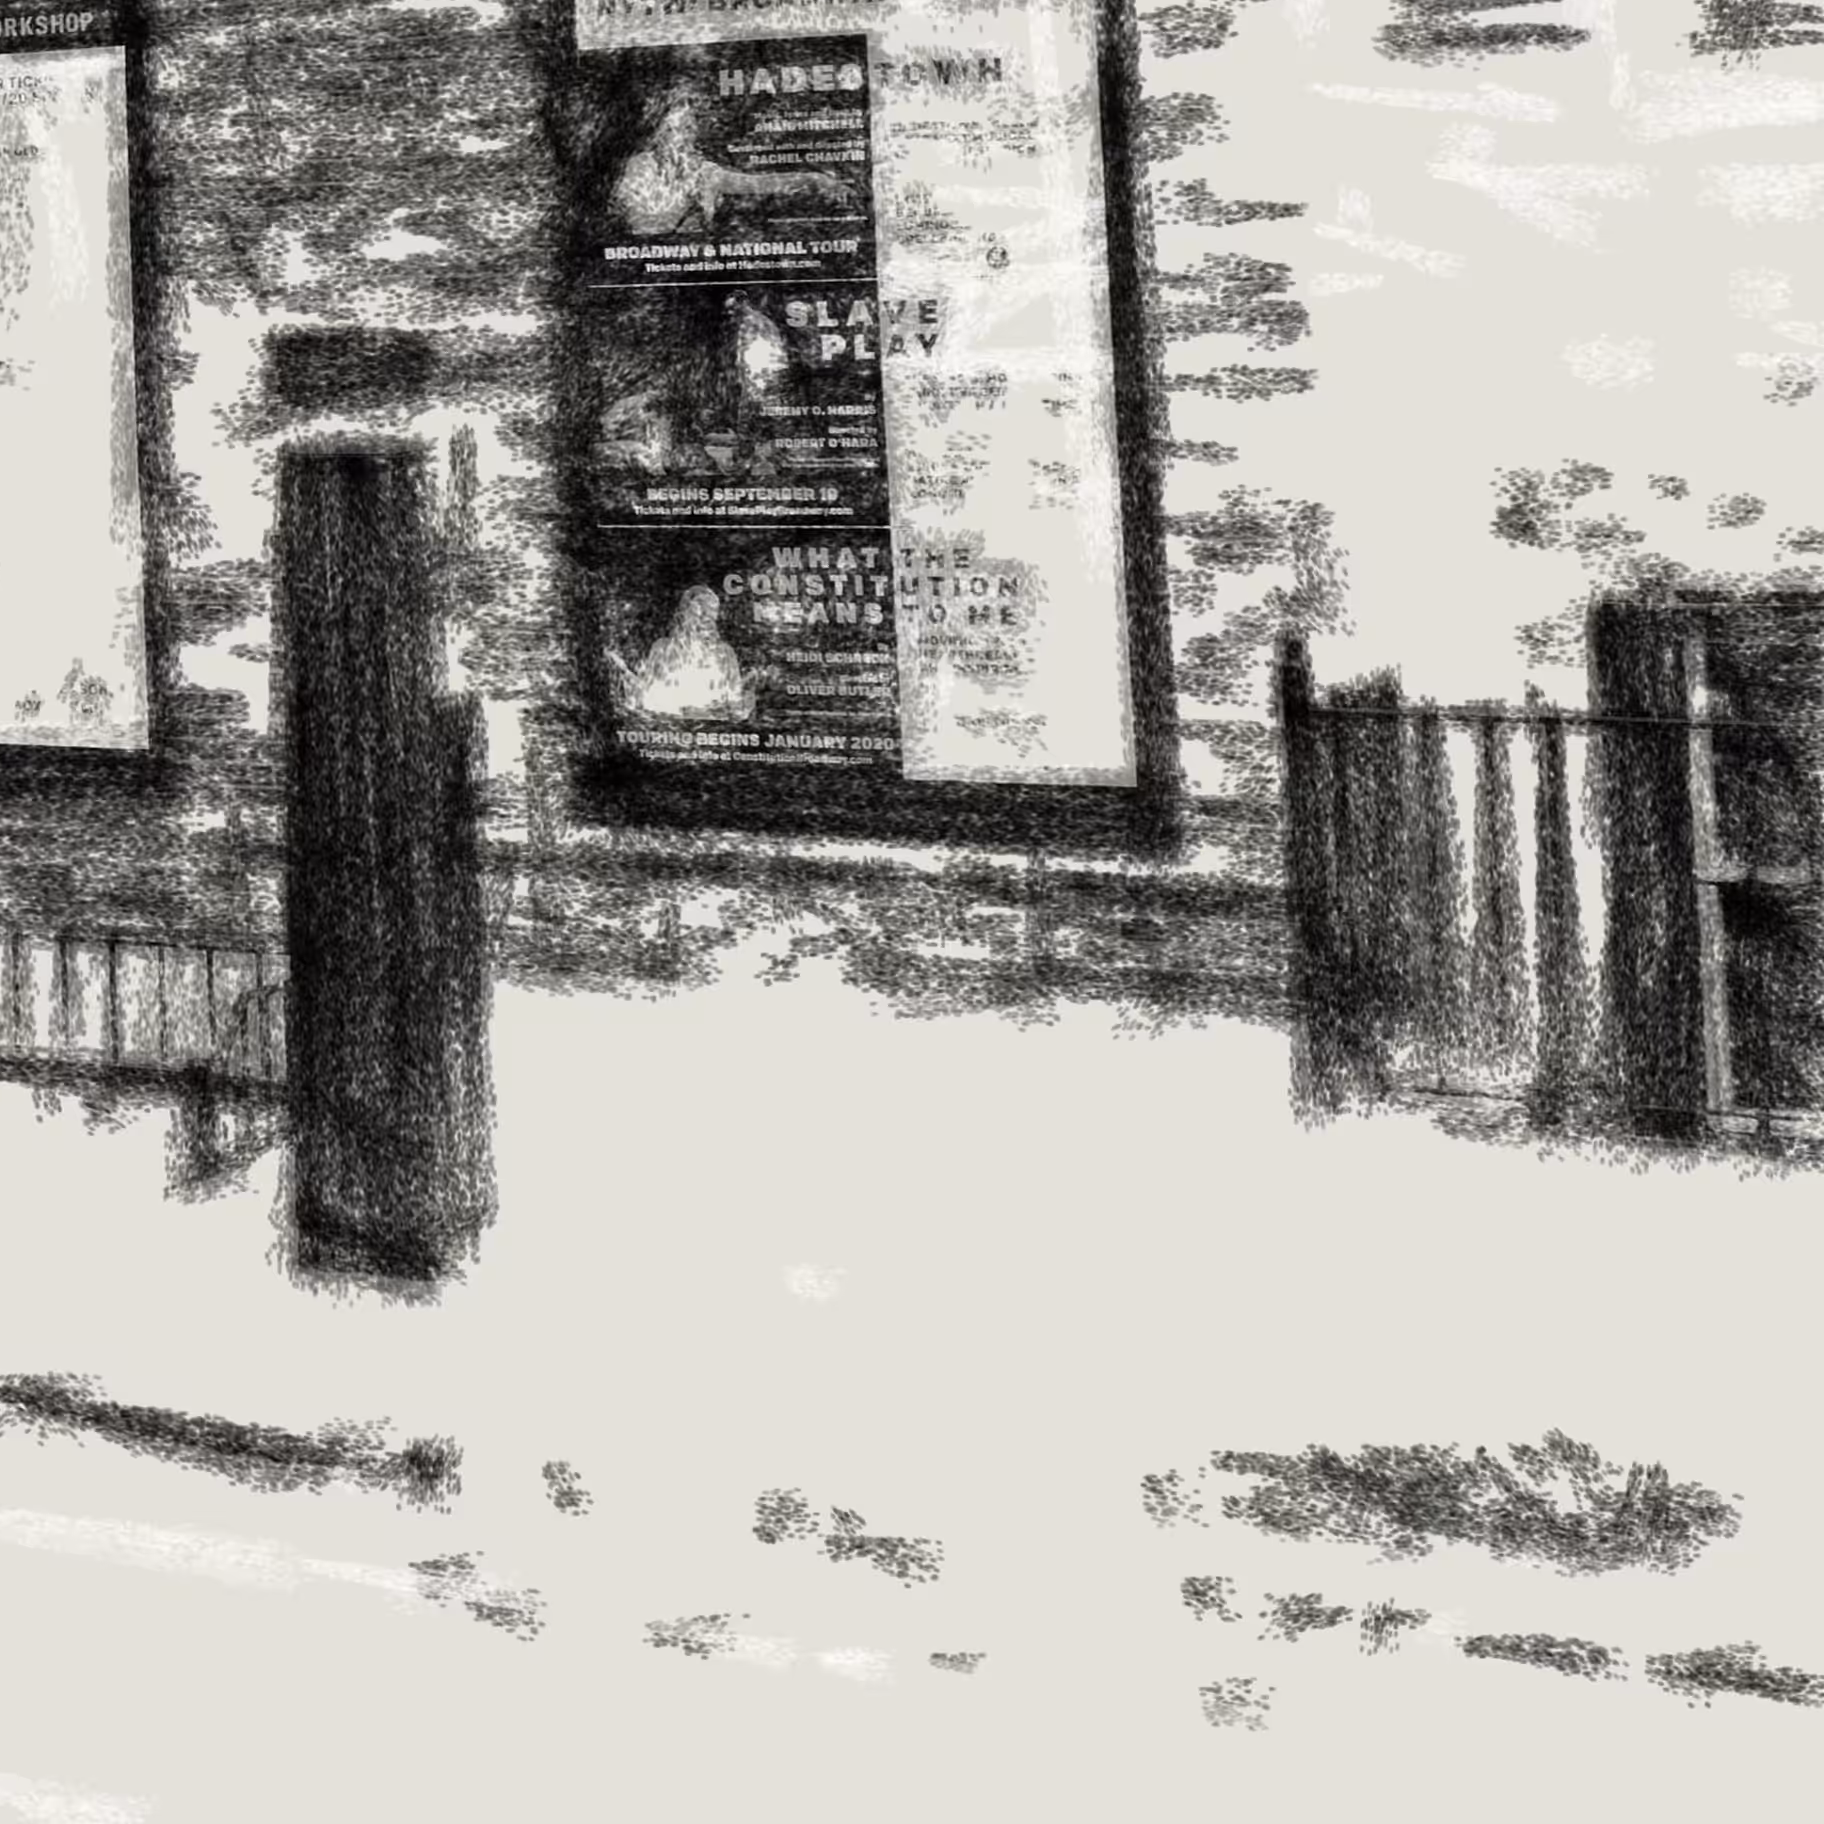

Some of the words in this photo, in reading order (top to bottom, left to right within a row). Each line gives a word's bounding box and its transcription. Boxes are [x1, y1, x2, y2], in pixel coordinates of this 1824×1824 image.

[9, 75, 54, 88] TICK
[718, 57, 1002, 96] HADESTOWN
[750, 152, 802, 165] RACHEL
[604, 243, 699, 260] BROADWAY
[702, 243, 717, 257] &
[720, 241, 807, 257] NATIONAL
[810, 239, 859, 254] TOUR
[645, 262, 682, 272] Tickets
[785, 299, 939, 327] SLAVE
[820, 333, 939, 361] PLAY
[759, 406, 808, 416] JEREMY
[812, 406, 826, 416] O.
[827, 405, 876, 416] HARRIS
[775, 438, 825, 449] ROBERT
[646, 487, 710, 502] BEGINS
[713, 487, 816, 502] SEPTEMBER
[772, 547, 879, 569] WHAT
[900, 547, 971, 569] THE
[723, 574, 1019, 597] CONSTITUTION
[753, 601, 884, 625] MEANS
[902, 603, 947, 625] TO
[968, 603, 1019, 625] ME
[786, 652, 823, 663] HEIDI
[786, 685, 836, 696] OLIVER
[616, 730, 695, 746] TOURING
[696, 733, 760, 747] BEGINS
[763, 734, 847, 749] JANUARY
[851, 736, 895, 750] 2020
